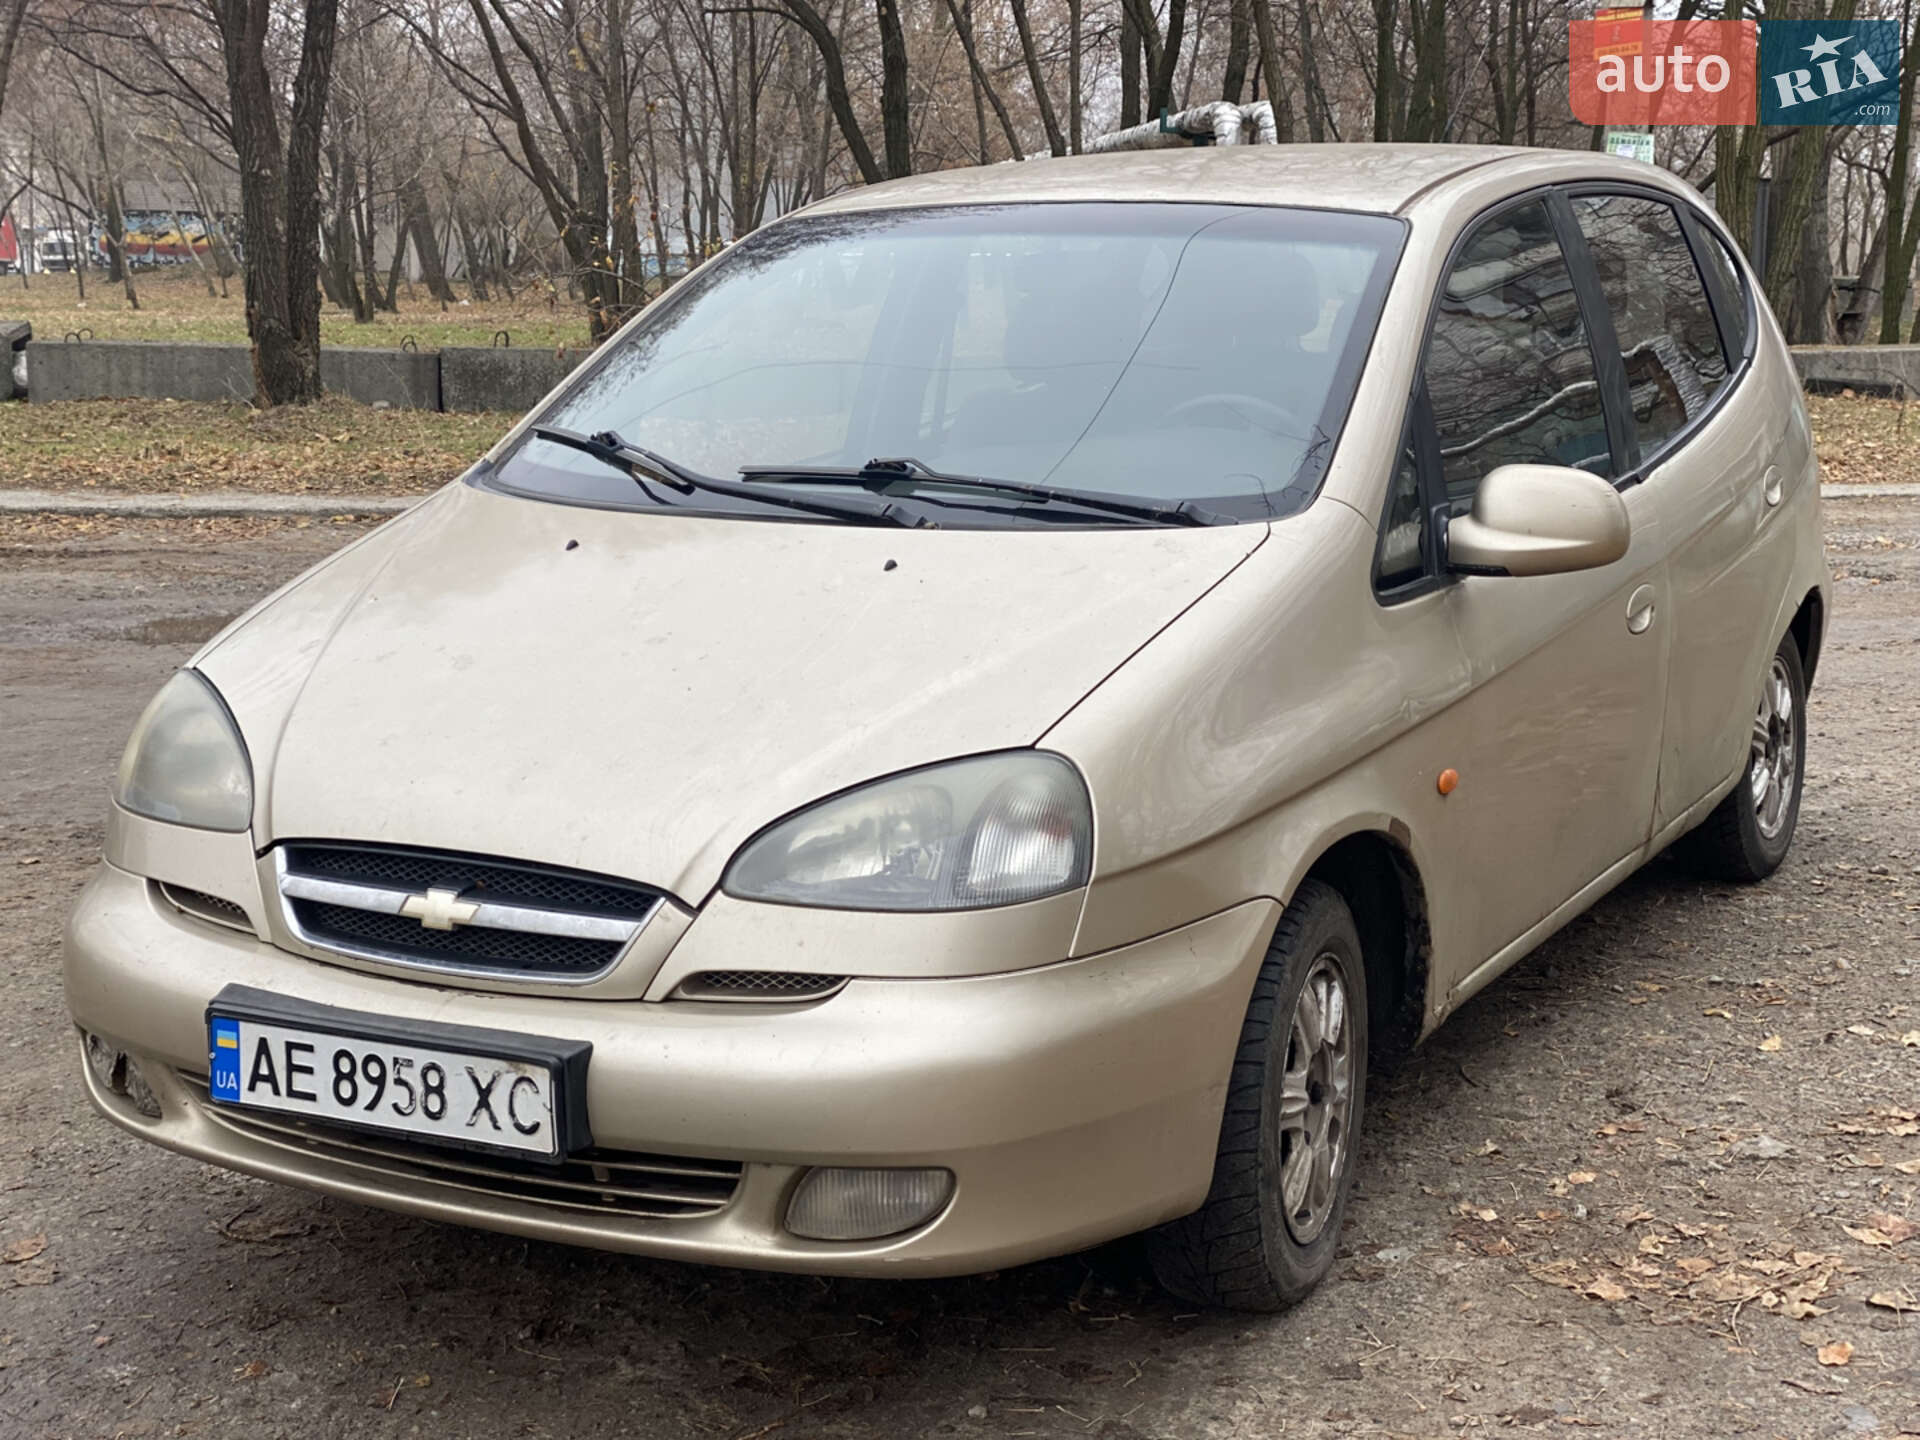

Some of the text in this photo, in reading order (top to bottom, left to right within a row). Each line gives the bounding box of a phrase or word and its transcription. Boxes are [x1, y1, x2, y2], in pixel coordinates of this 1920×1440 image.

[216, 1036, 542, 1136] UA AE 8958 XC
